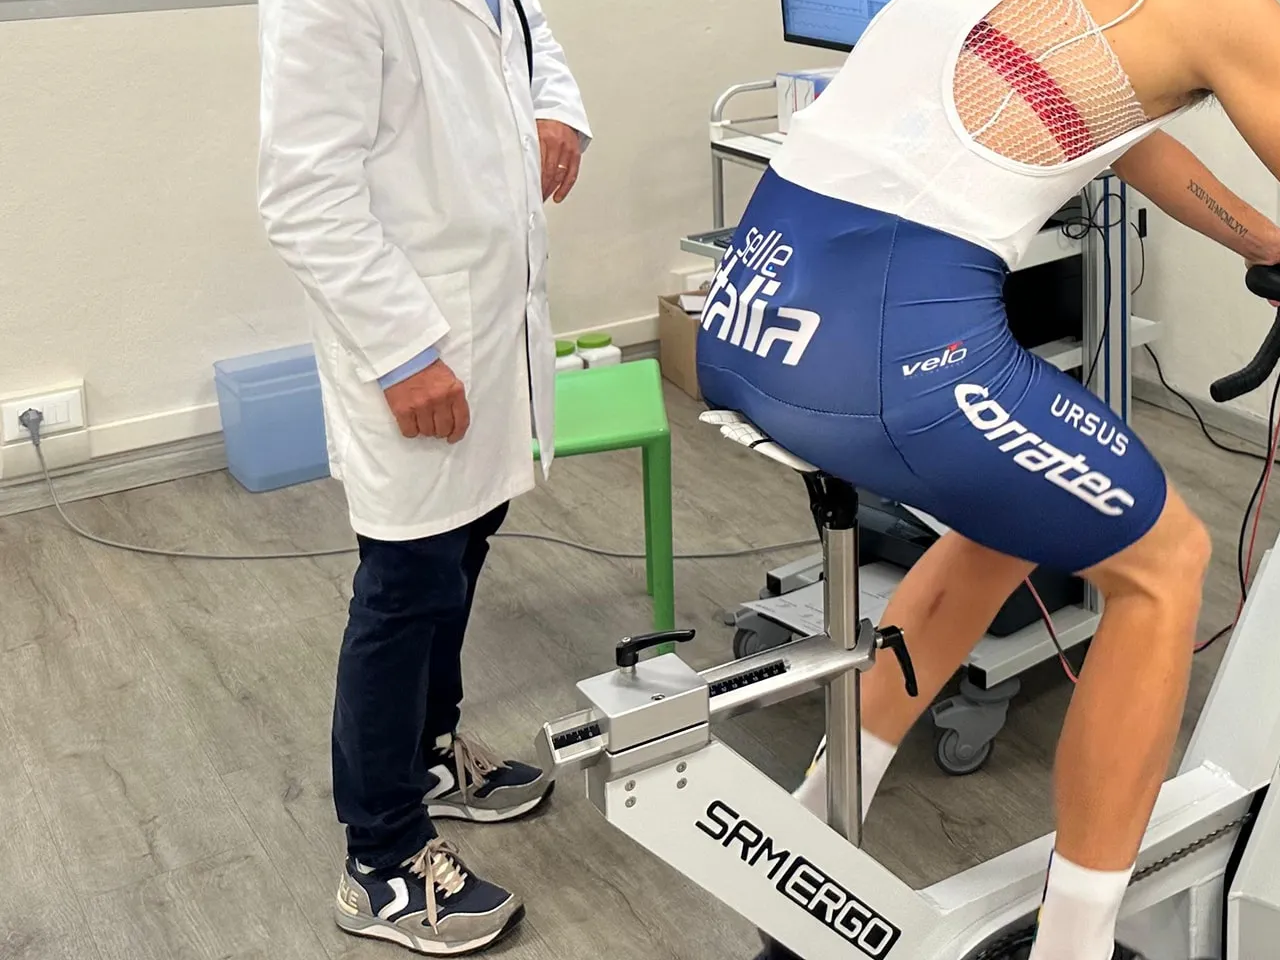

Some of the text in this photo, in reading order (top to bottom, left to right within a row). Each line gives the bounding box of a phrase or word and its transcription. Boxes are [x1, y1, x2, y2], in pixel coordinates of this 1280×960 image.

[736, 226, 794, 278] selle
[700, 244, 821, 366] italia
[1050, 393, 1129, 458] URSUS
[695, 799, 898, 958] SRM ERGO
